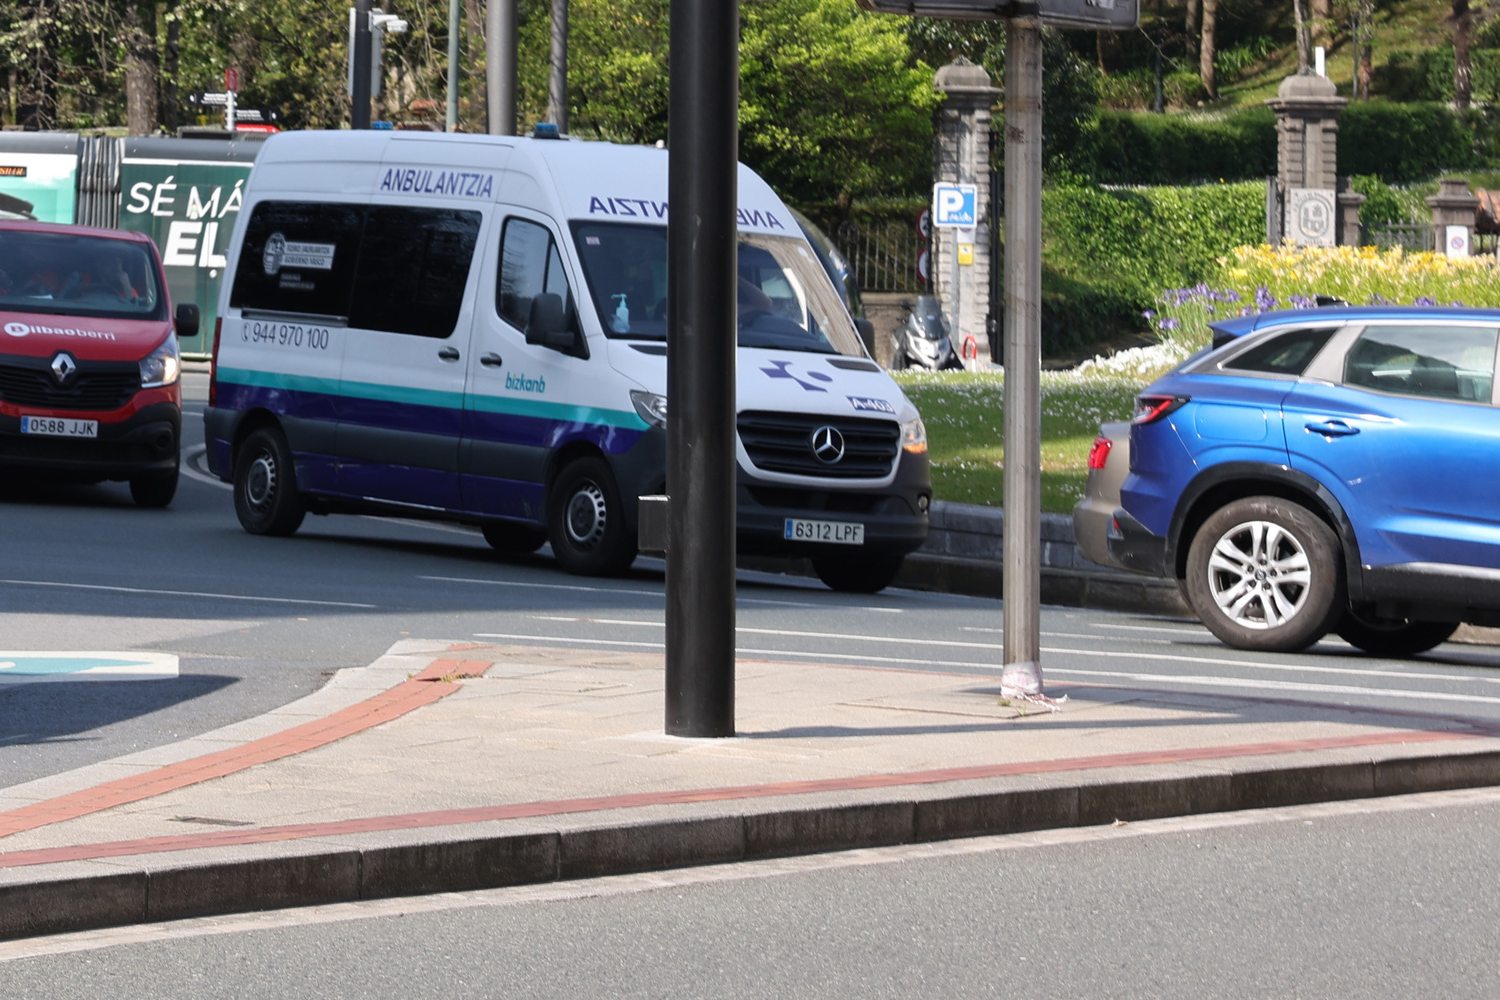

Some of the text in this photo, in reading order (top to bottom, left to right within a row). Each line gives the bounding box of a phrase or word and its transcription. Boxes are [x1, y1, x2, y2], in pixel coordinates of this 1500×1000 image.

[126, 175, 178, 217] SÉ
[380, 168, 494, 198] ANBULANTZIA
[939, 189, 965, 222] P
[253, 322, 329, 350] 944 970 100
[30, 419, 94, 436] 0588 JJK
[796, 522, 860, 542] 6312 LPF
